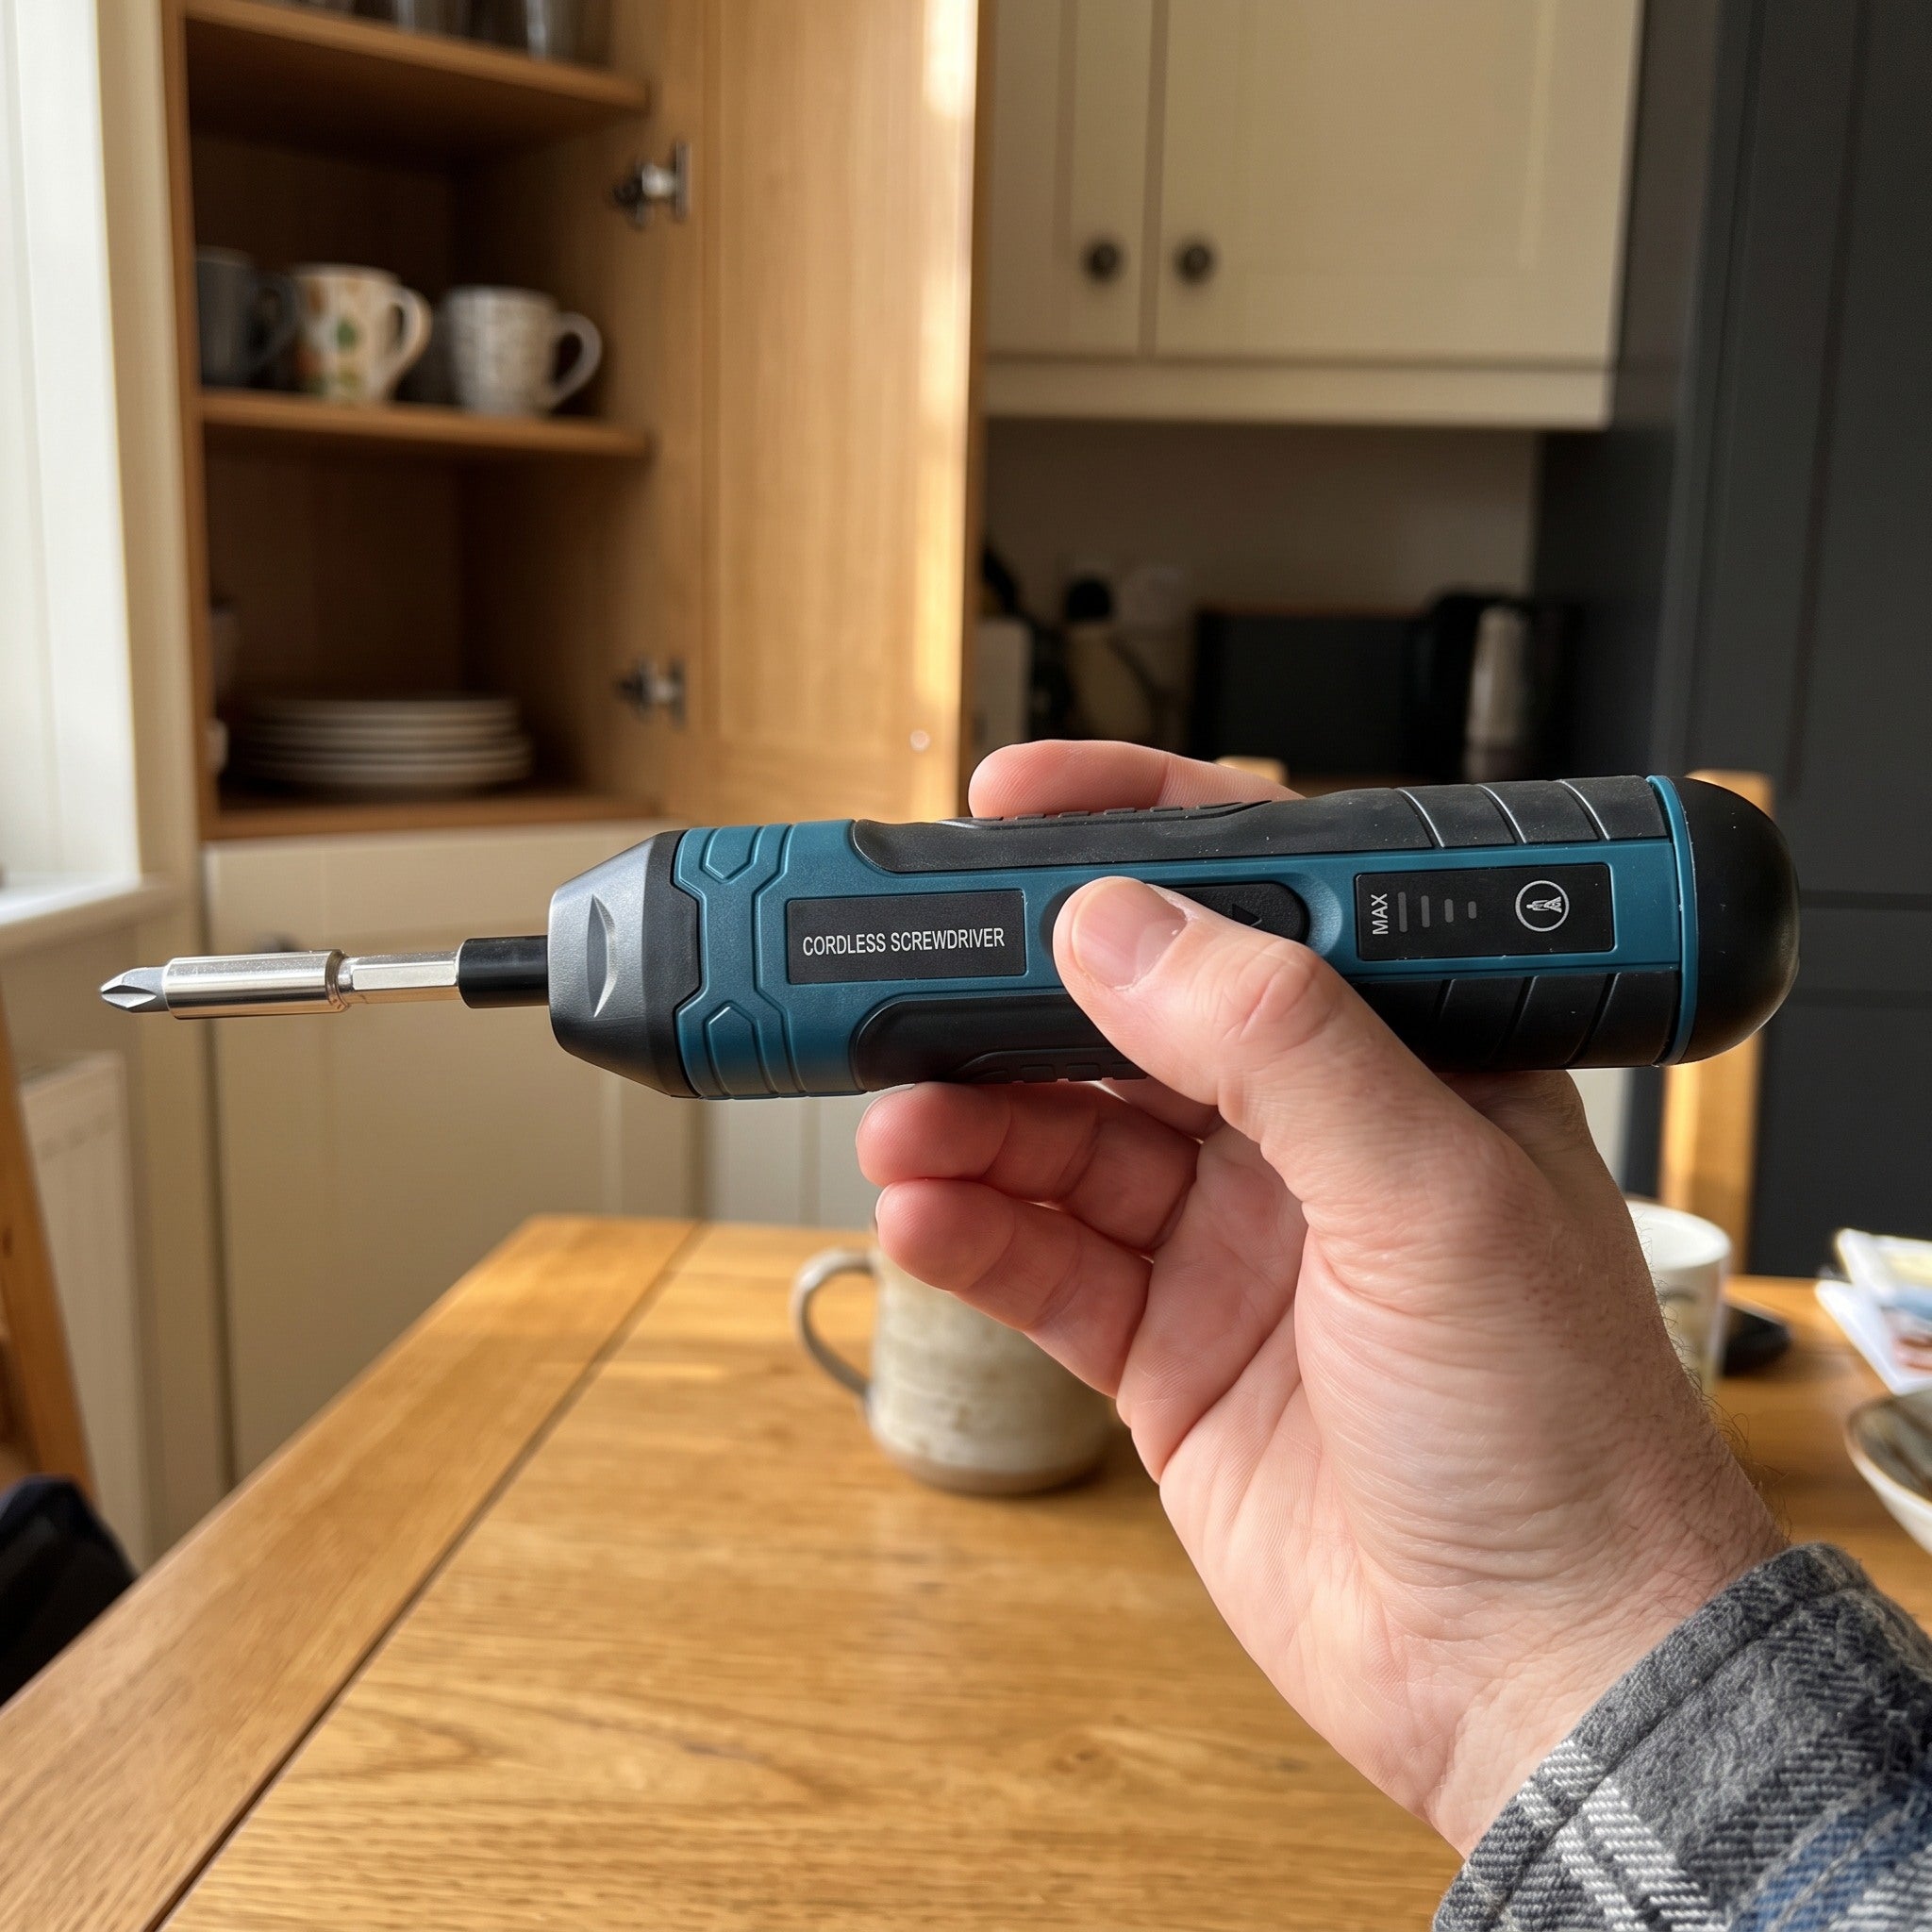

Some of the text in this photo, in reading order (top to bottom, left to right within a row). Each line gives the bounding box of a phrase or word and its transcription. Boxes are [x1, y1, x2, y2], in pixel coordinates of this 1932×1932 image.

[1371, 893, 1389, 935] MAX
[803, 927, 1006, 957] CORDLESS SCREWDRIVER
